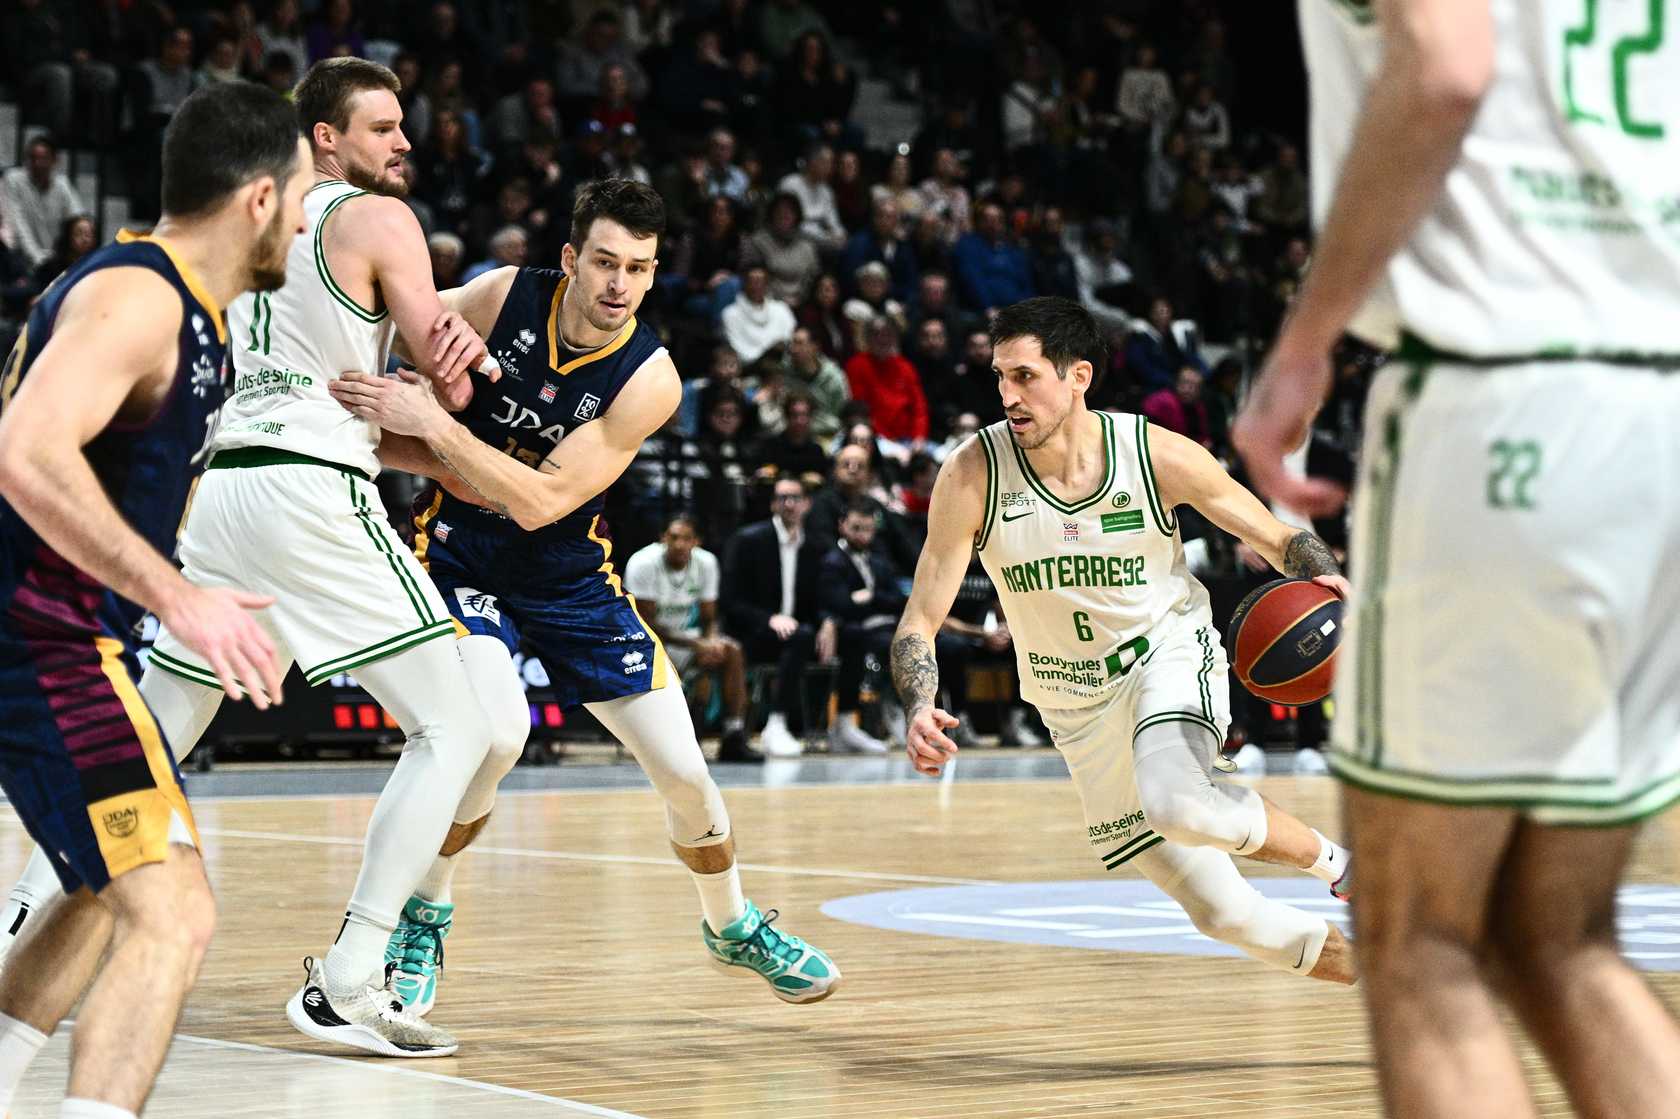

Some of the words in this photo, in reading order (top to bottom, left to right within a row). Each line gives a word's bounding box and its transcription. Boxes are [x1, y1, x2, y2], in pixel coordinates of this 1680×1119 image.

[585, 398, 596, 409] 10
[490, 395, 565, 445] JDA
[1487, 439, 1542, 511] 22
[1001, 499, 1036, 507] SPORT
[1073, 610, 1095, 642] 6
[624, 662, 648, 675] errea
[1029, 652, 1101, 672] Bouygues
